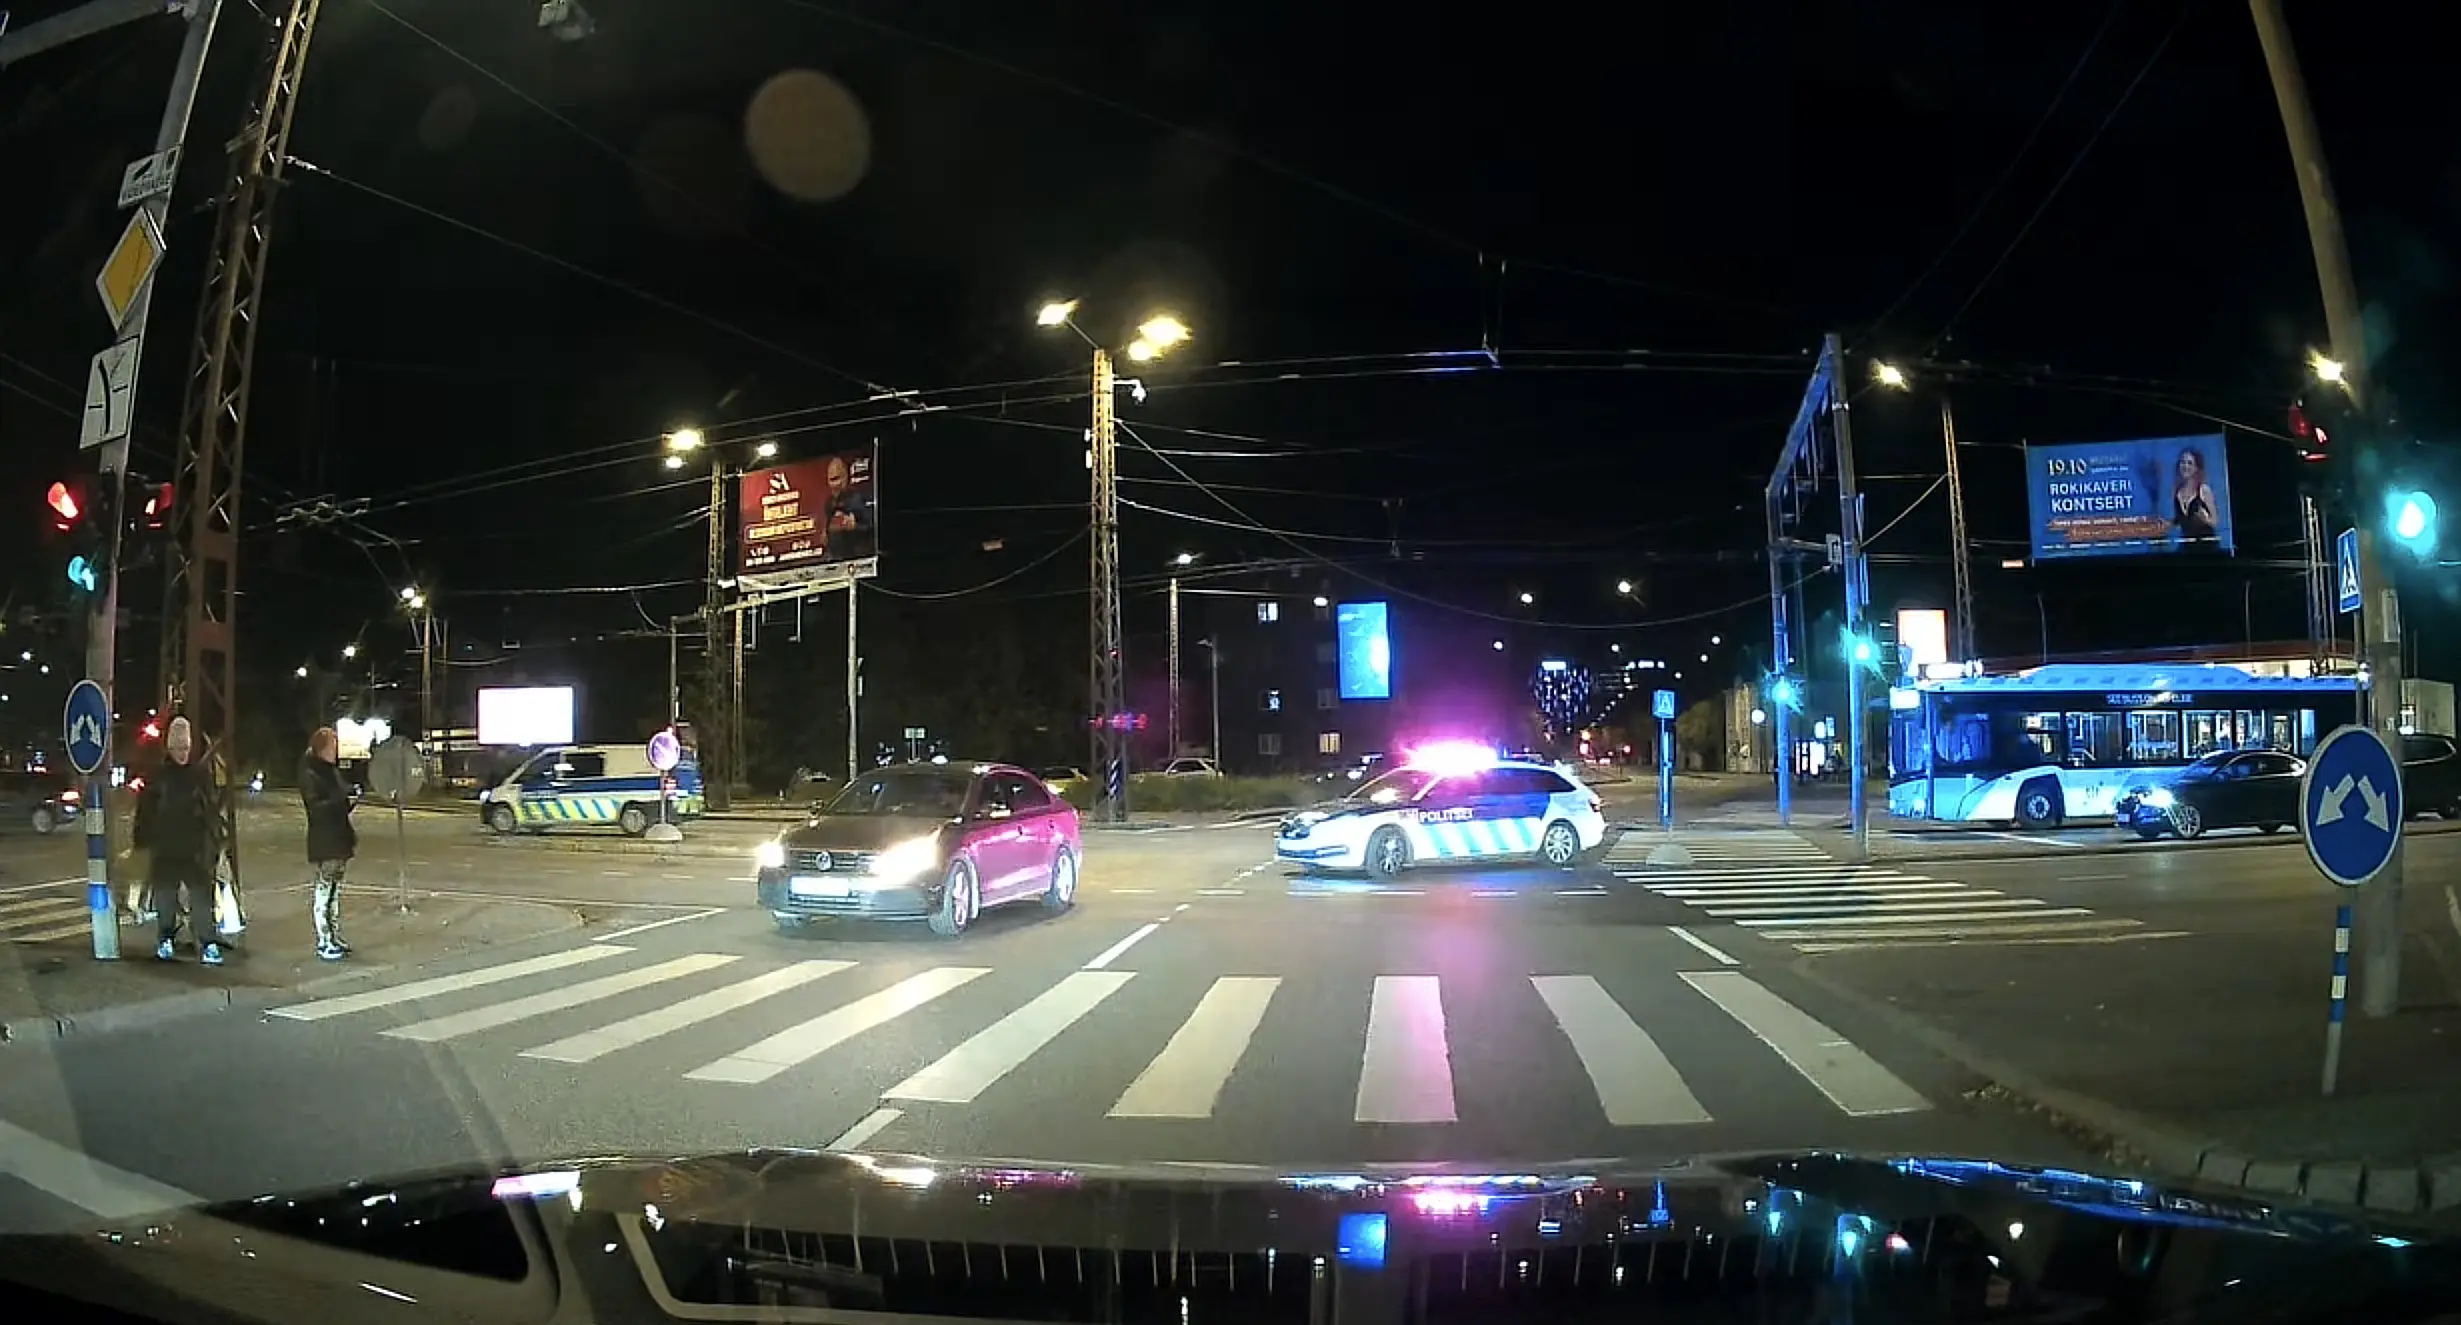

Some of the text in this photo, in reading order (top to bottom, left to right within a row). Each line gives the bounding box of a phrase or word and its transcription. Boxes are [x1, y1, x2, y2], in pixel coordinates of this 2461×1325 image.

[2048, 458, 2087, 477] 19.10
[2050, 479, 2132, 496] ROKIKAVERI
[2051, 495, 2133, 514] KONTSERT
[1419, 807, 1474, 823] POLITSEI
